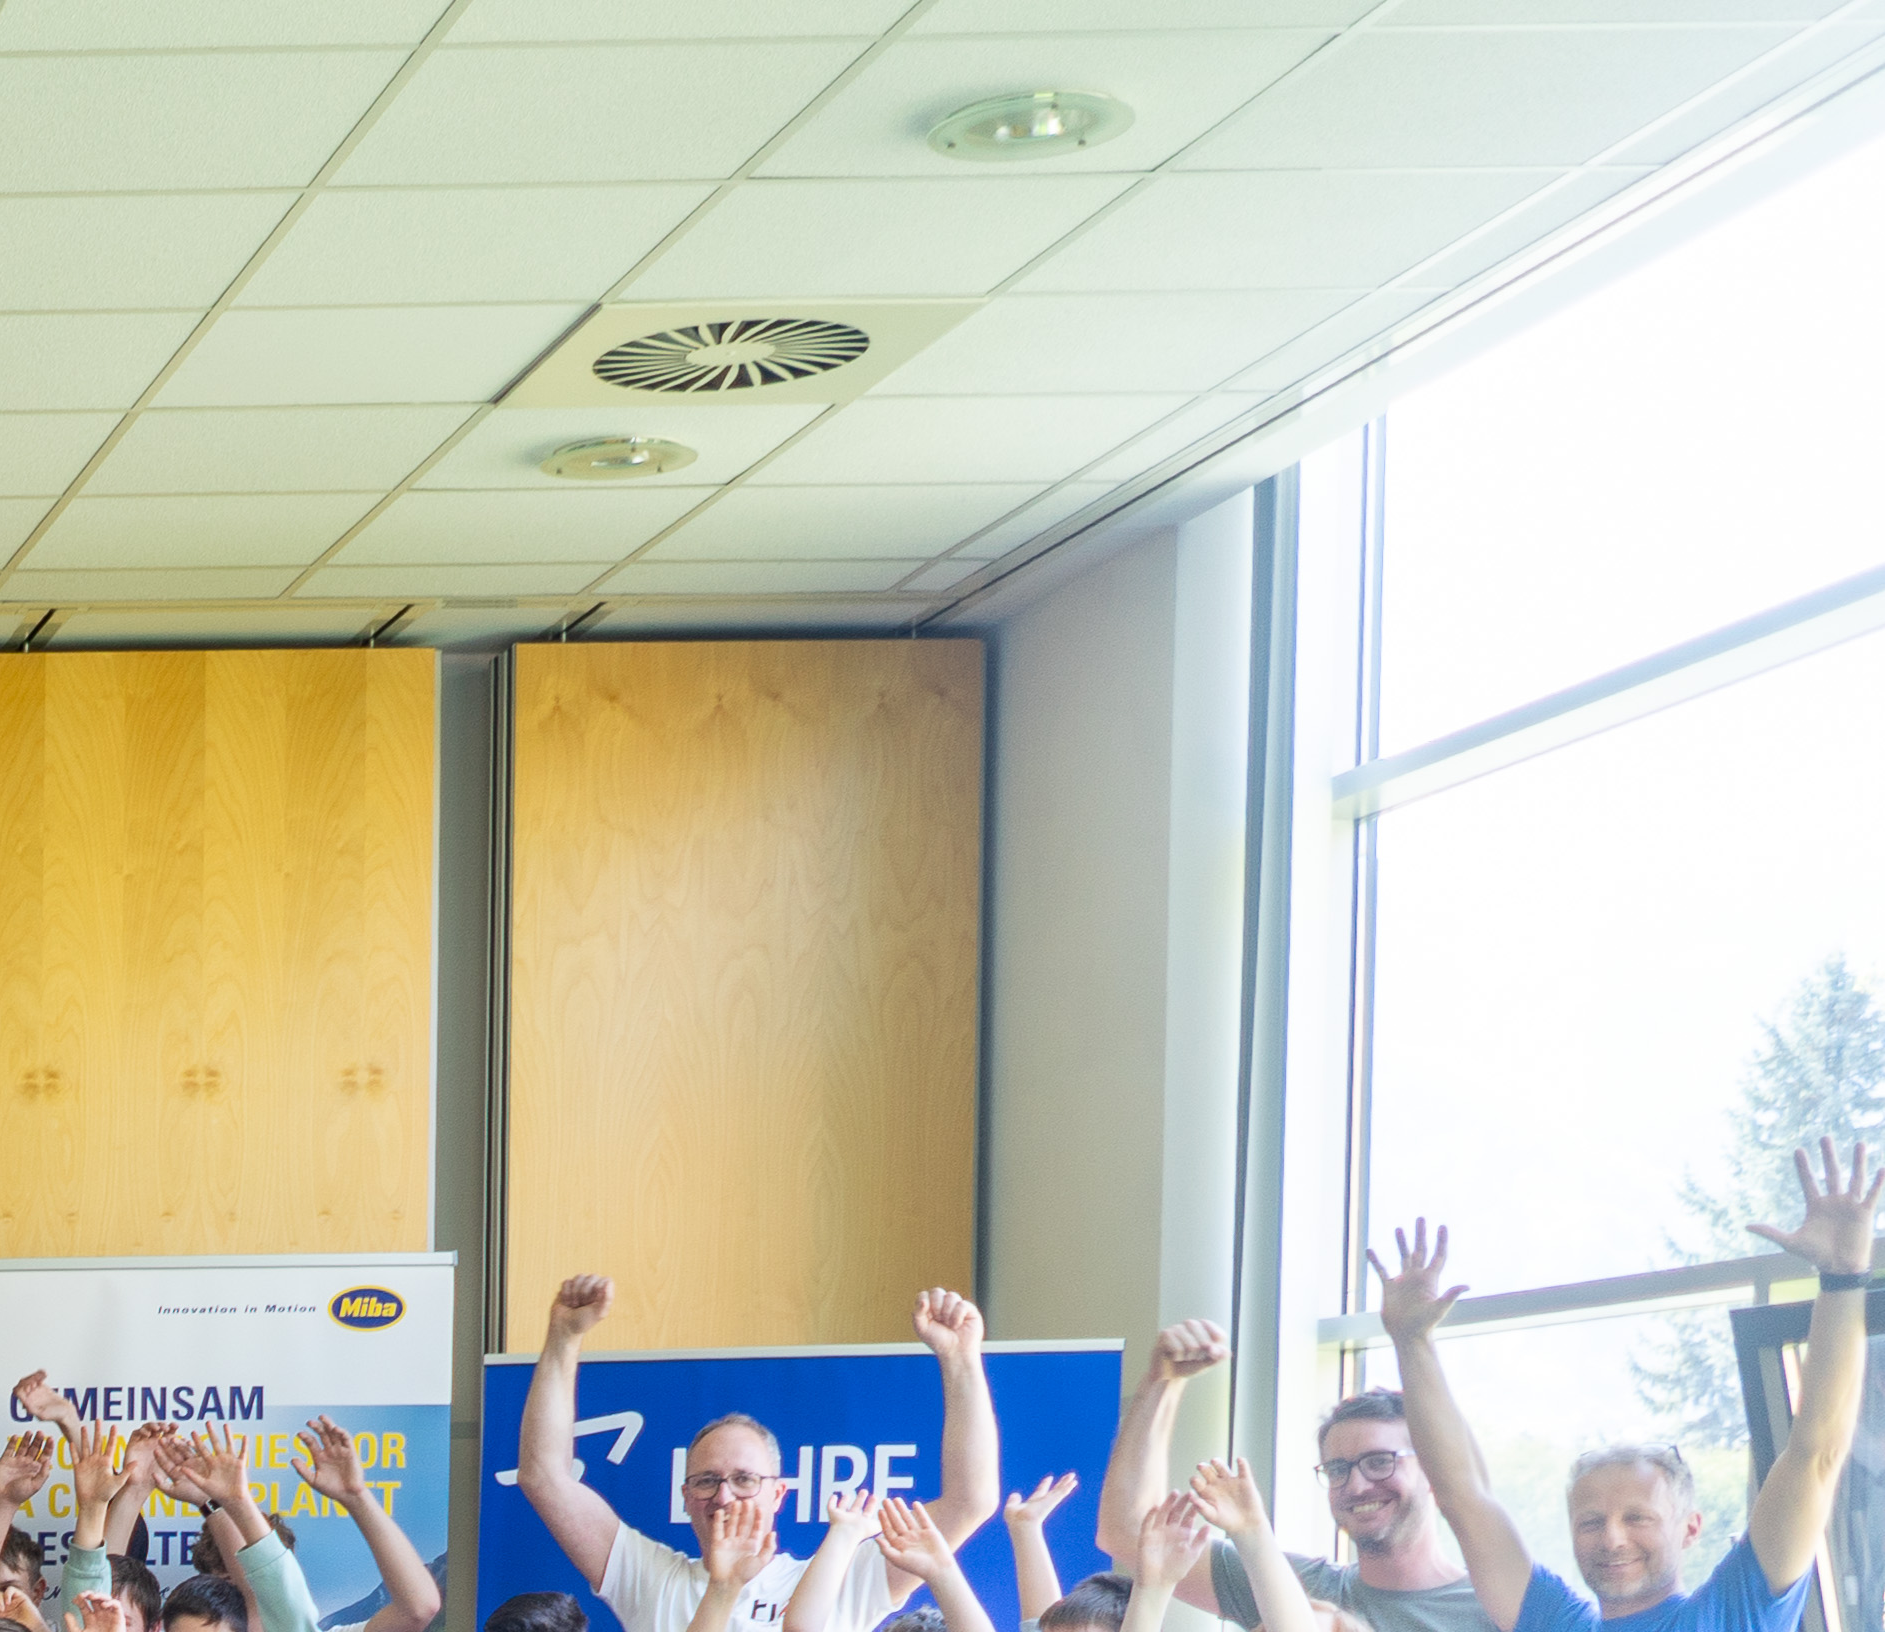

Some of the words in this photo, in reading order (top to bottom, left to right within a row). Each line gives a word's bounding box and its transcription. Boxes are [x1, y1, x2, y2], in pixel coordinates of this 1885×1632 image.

[157, 1304, 237, 1315] Innovation
[244, 1303, 258, 1314] in
[263, 1303, 317, 1314] Motion
[337, 1296, 399, 1320] Miba
[10, 1385, 265, 1421] GMEINSAM
[669, 1444, 918, 1524] LHRE
